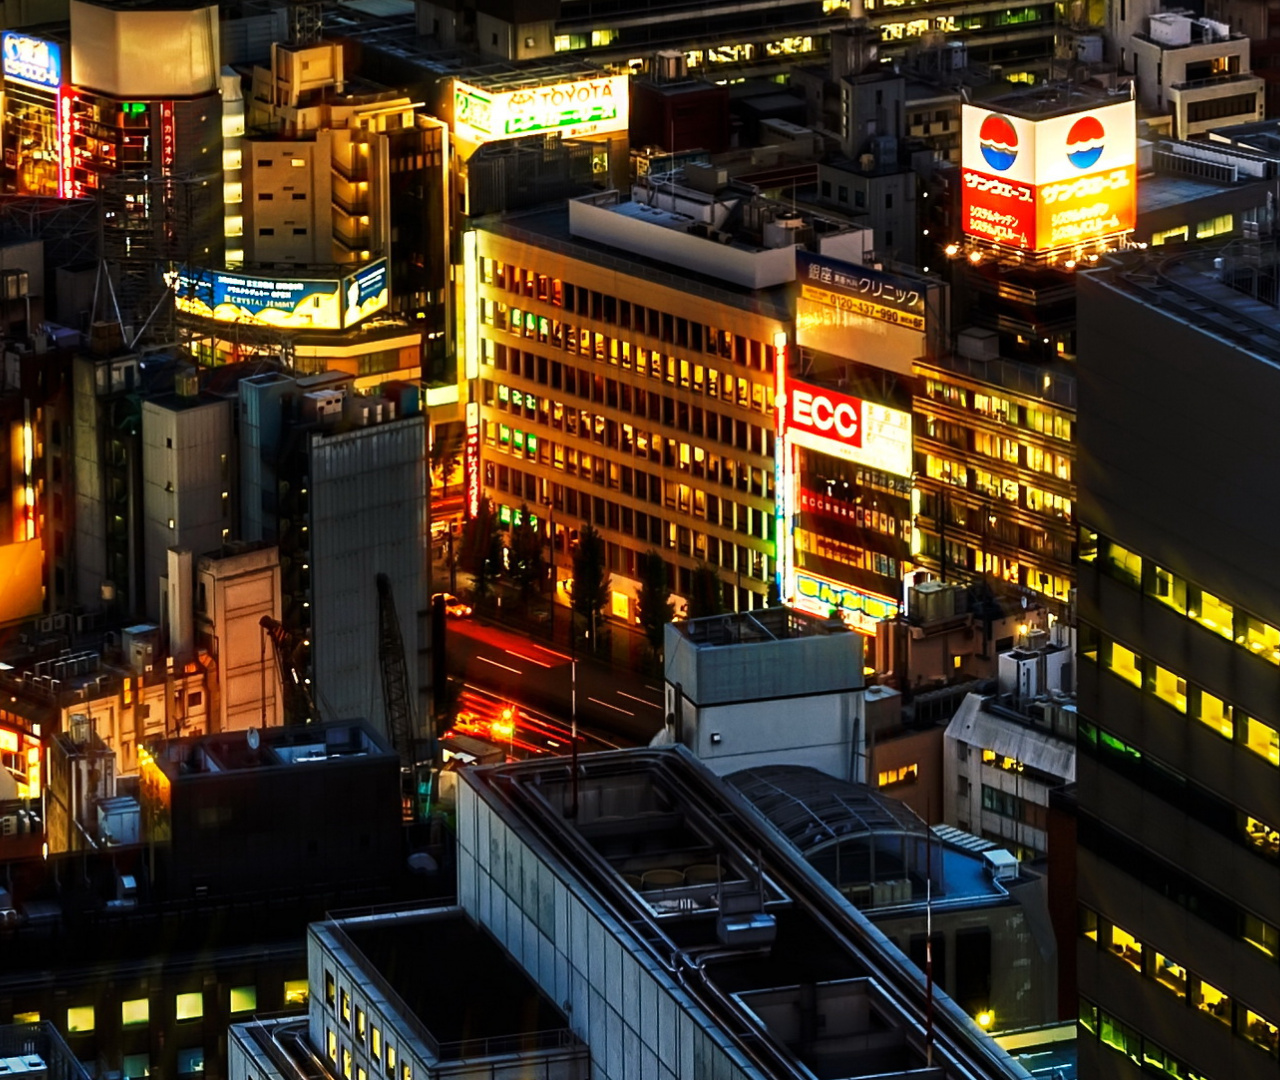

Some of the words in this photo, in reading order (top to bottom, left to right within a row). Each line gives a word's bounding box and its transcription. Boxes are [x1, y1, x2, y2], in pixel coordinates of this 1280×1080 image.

[540, 83, 614, 108] TOYOTA
[231, 296, 264, 308] CRYSTAL
[830, 294, 898, 322] 0120-437-990
[792, 389, 858, 438] ECC
